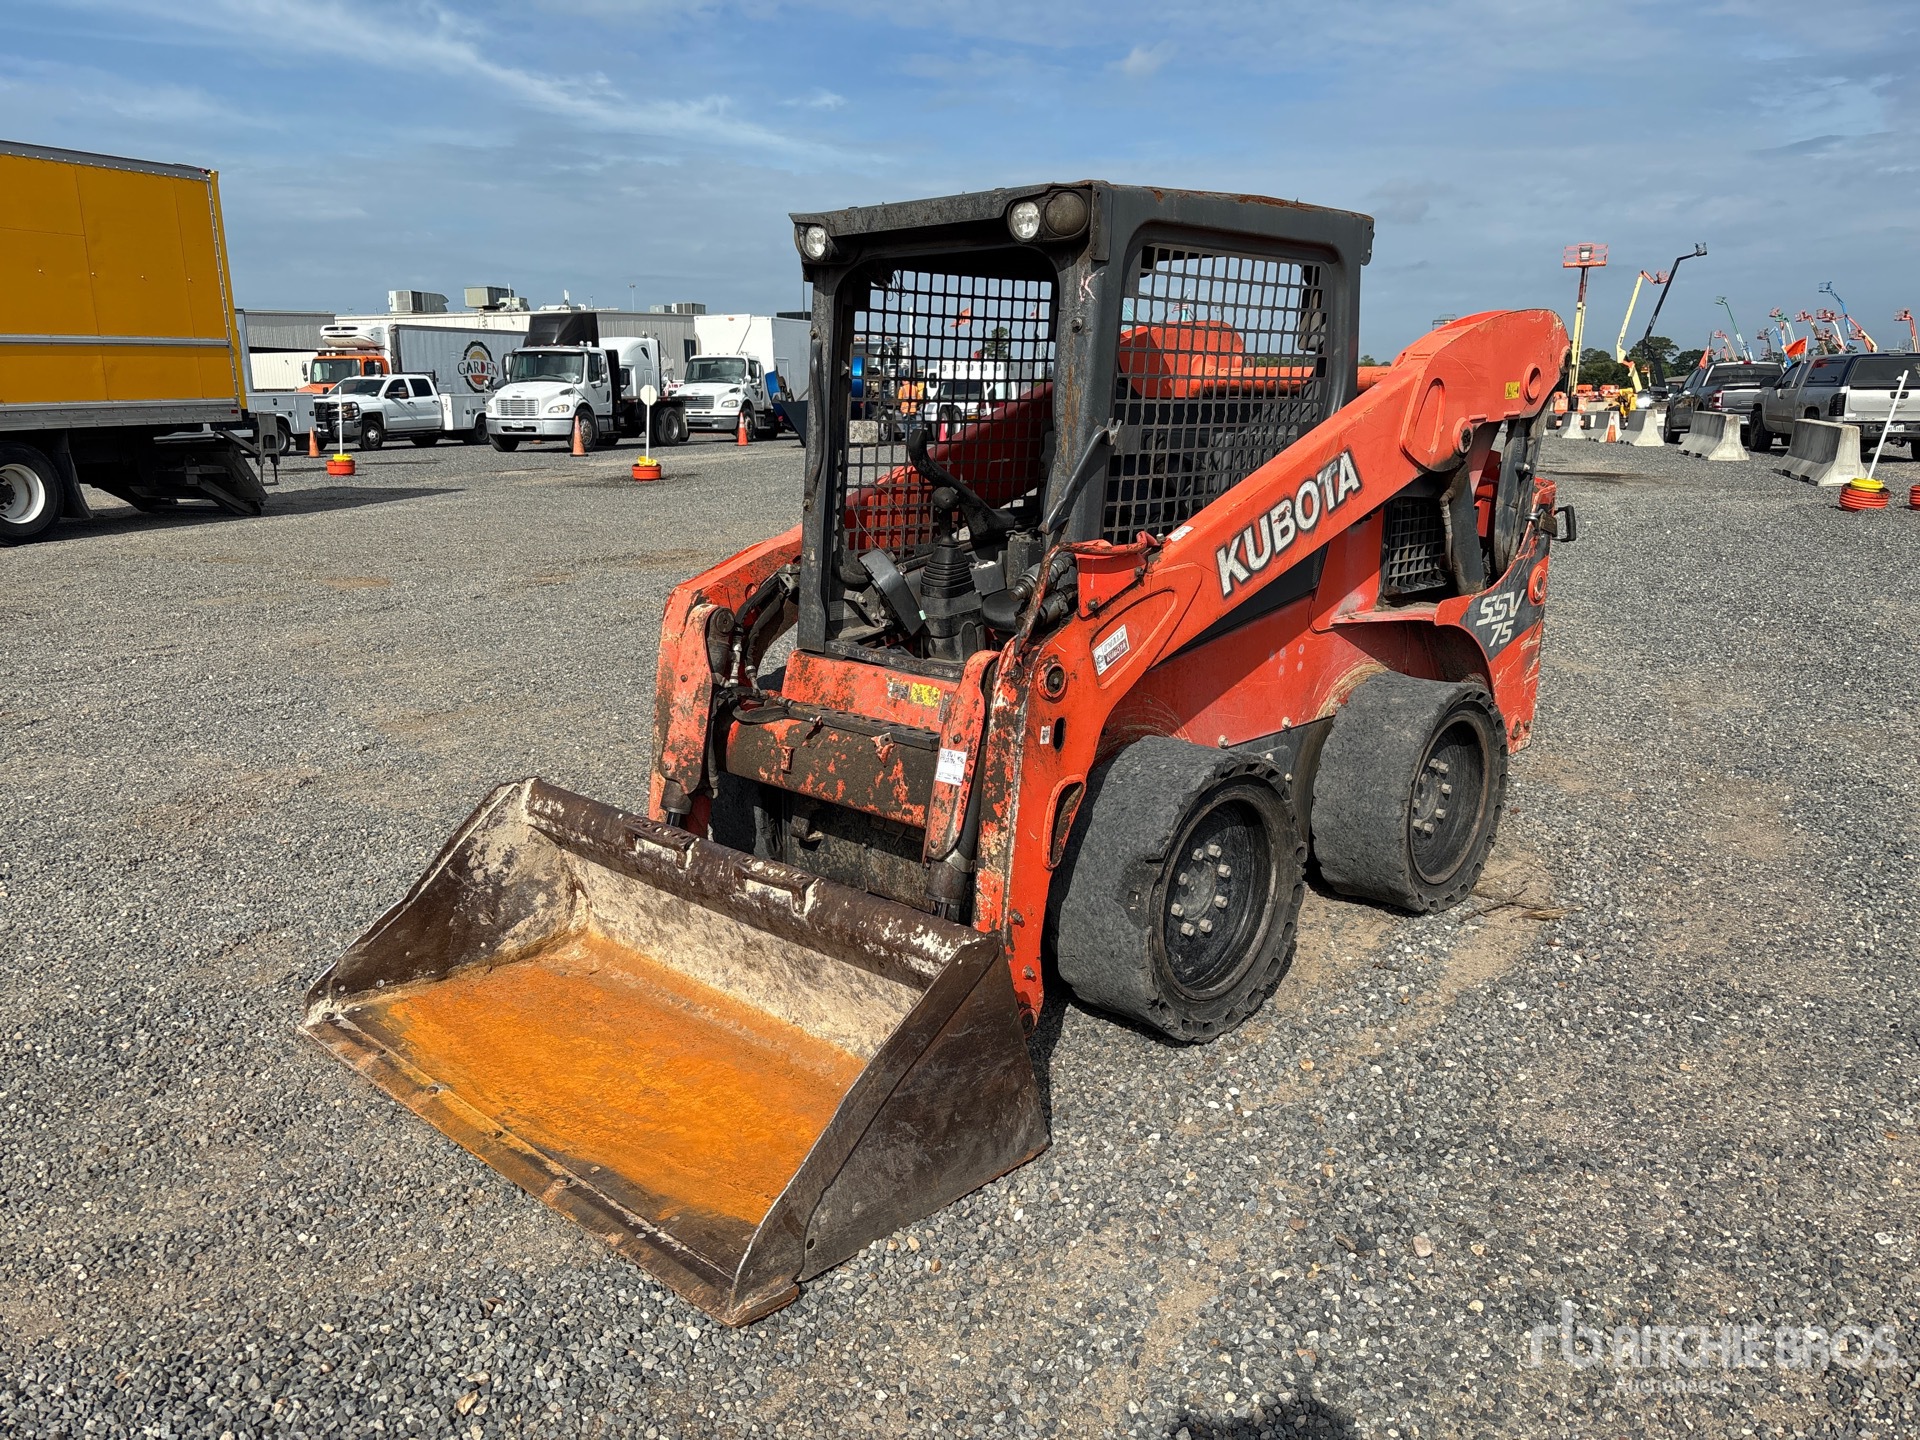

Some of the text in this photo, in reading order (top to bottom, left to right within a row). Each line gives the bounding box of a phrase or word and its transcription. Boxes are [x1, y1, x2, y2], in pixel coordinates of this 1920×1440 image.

[457, 360, 499, 377] GARDEN
[1215, 451, 1360, 598] KUBOTA
[1476, 588, 1527, 626] SSV
[1489, 620, 1514, 647] 75
